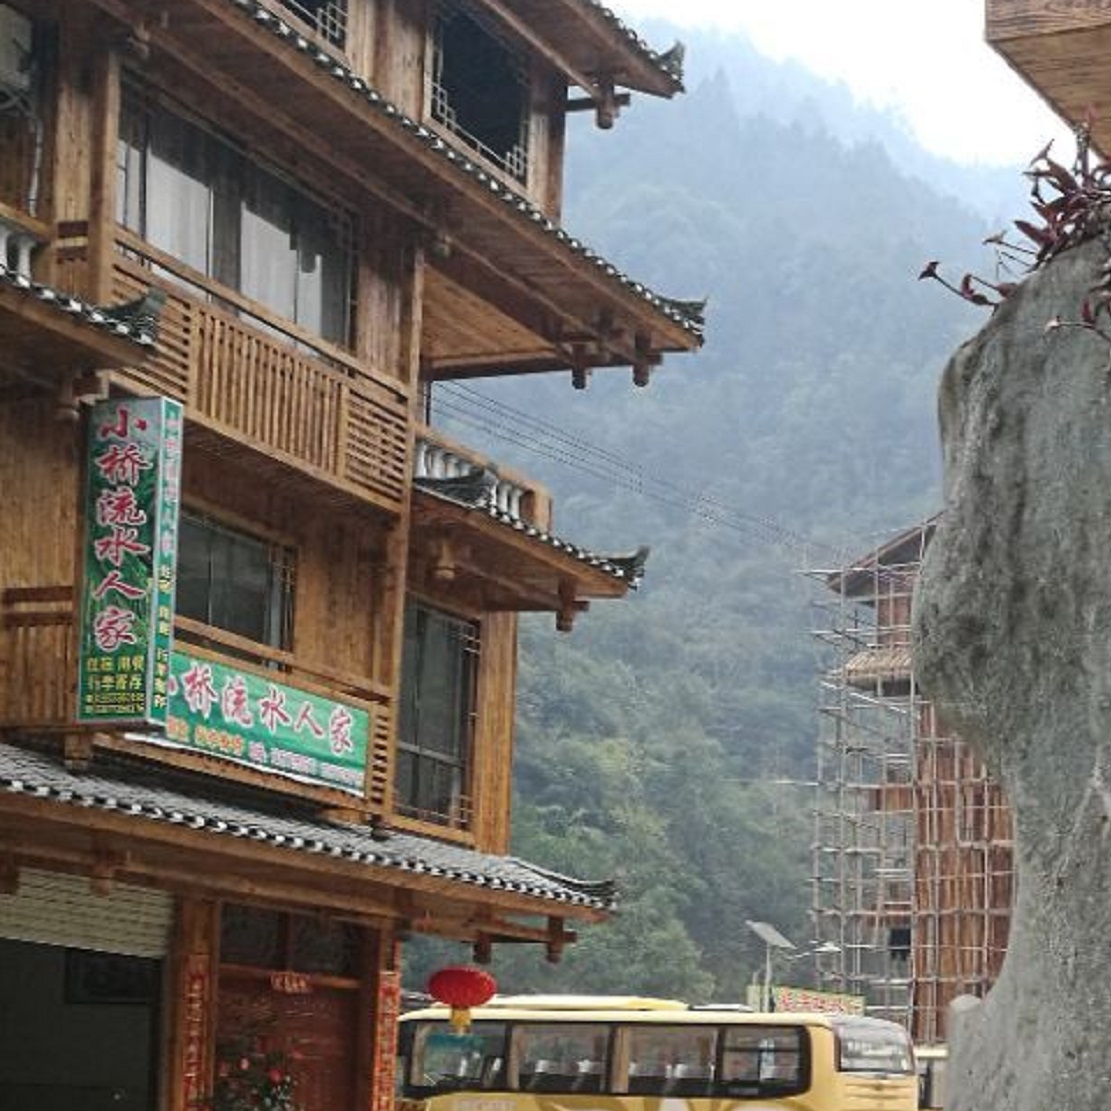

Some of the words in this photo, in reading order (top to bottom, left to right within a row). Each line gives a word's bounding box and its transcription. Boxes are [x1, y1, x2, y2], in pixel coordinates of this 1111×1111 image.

[93, 407, 151, 650] 小桥流水人家
[168, 660, 354, 756] 桥流水人家
